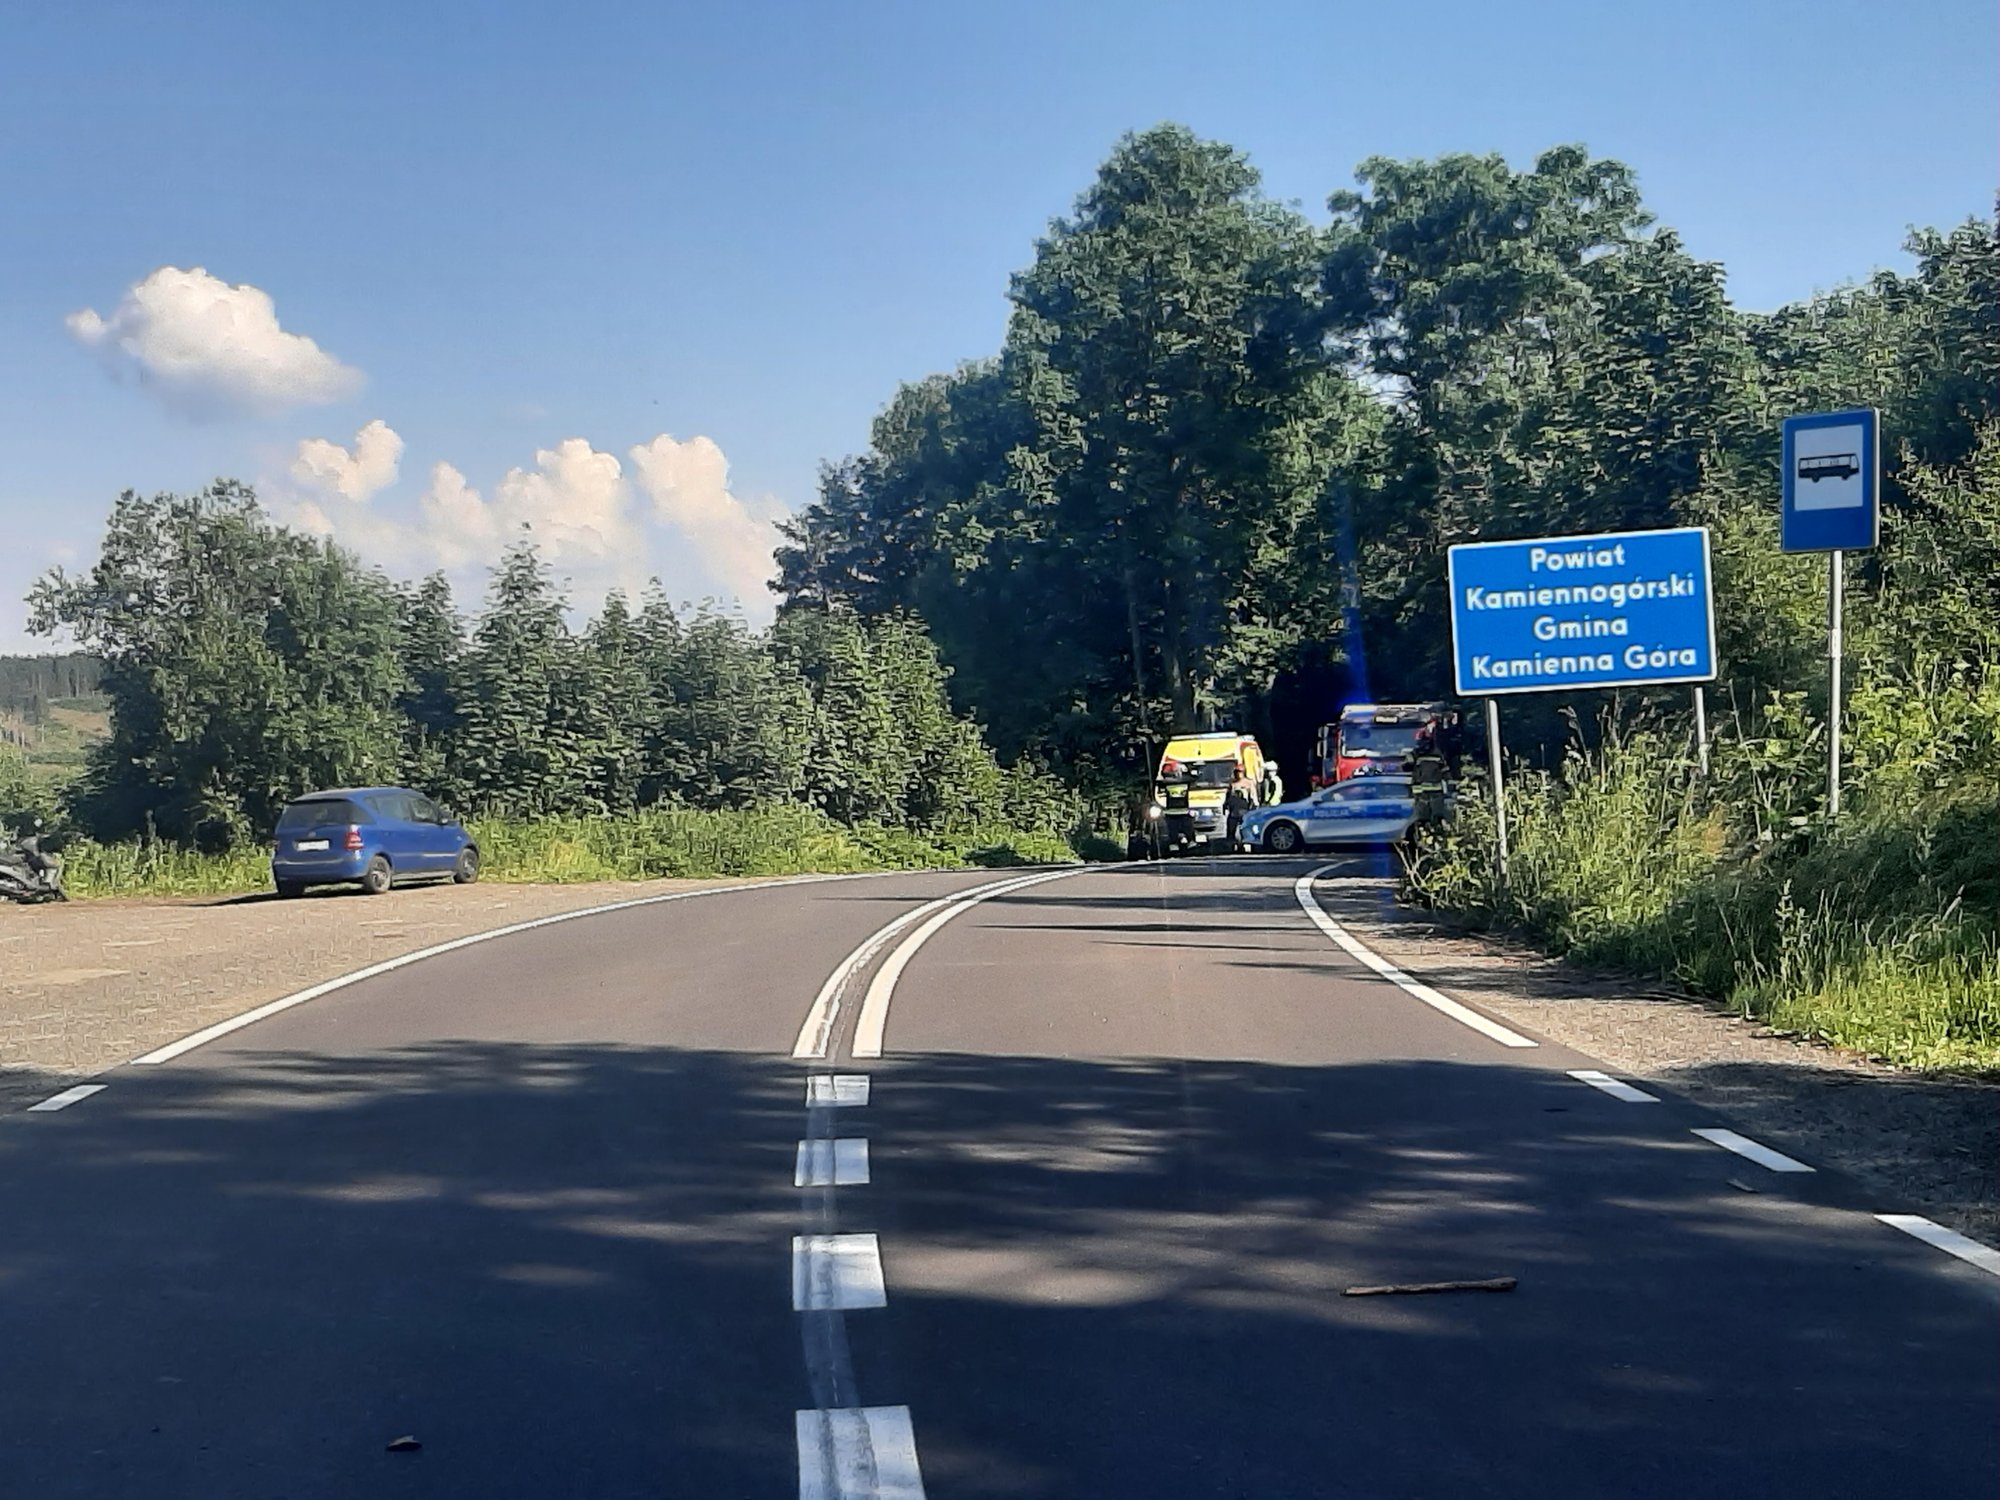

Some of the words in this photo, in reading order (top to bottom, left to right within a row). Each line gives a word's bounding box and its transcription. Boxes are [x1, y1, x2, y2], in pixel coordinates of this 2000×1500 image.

[1530, 543, 1626, 572] Powiat
[1465, 573, 1696, 611] Kamiennogórski
[1533, 614, 1629, 641] Gmina
[1472, 651, 1614, 679] Kamienna
[1623, 643, 1697, 670] Góra
